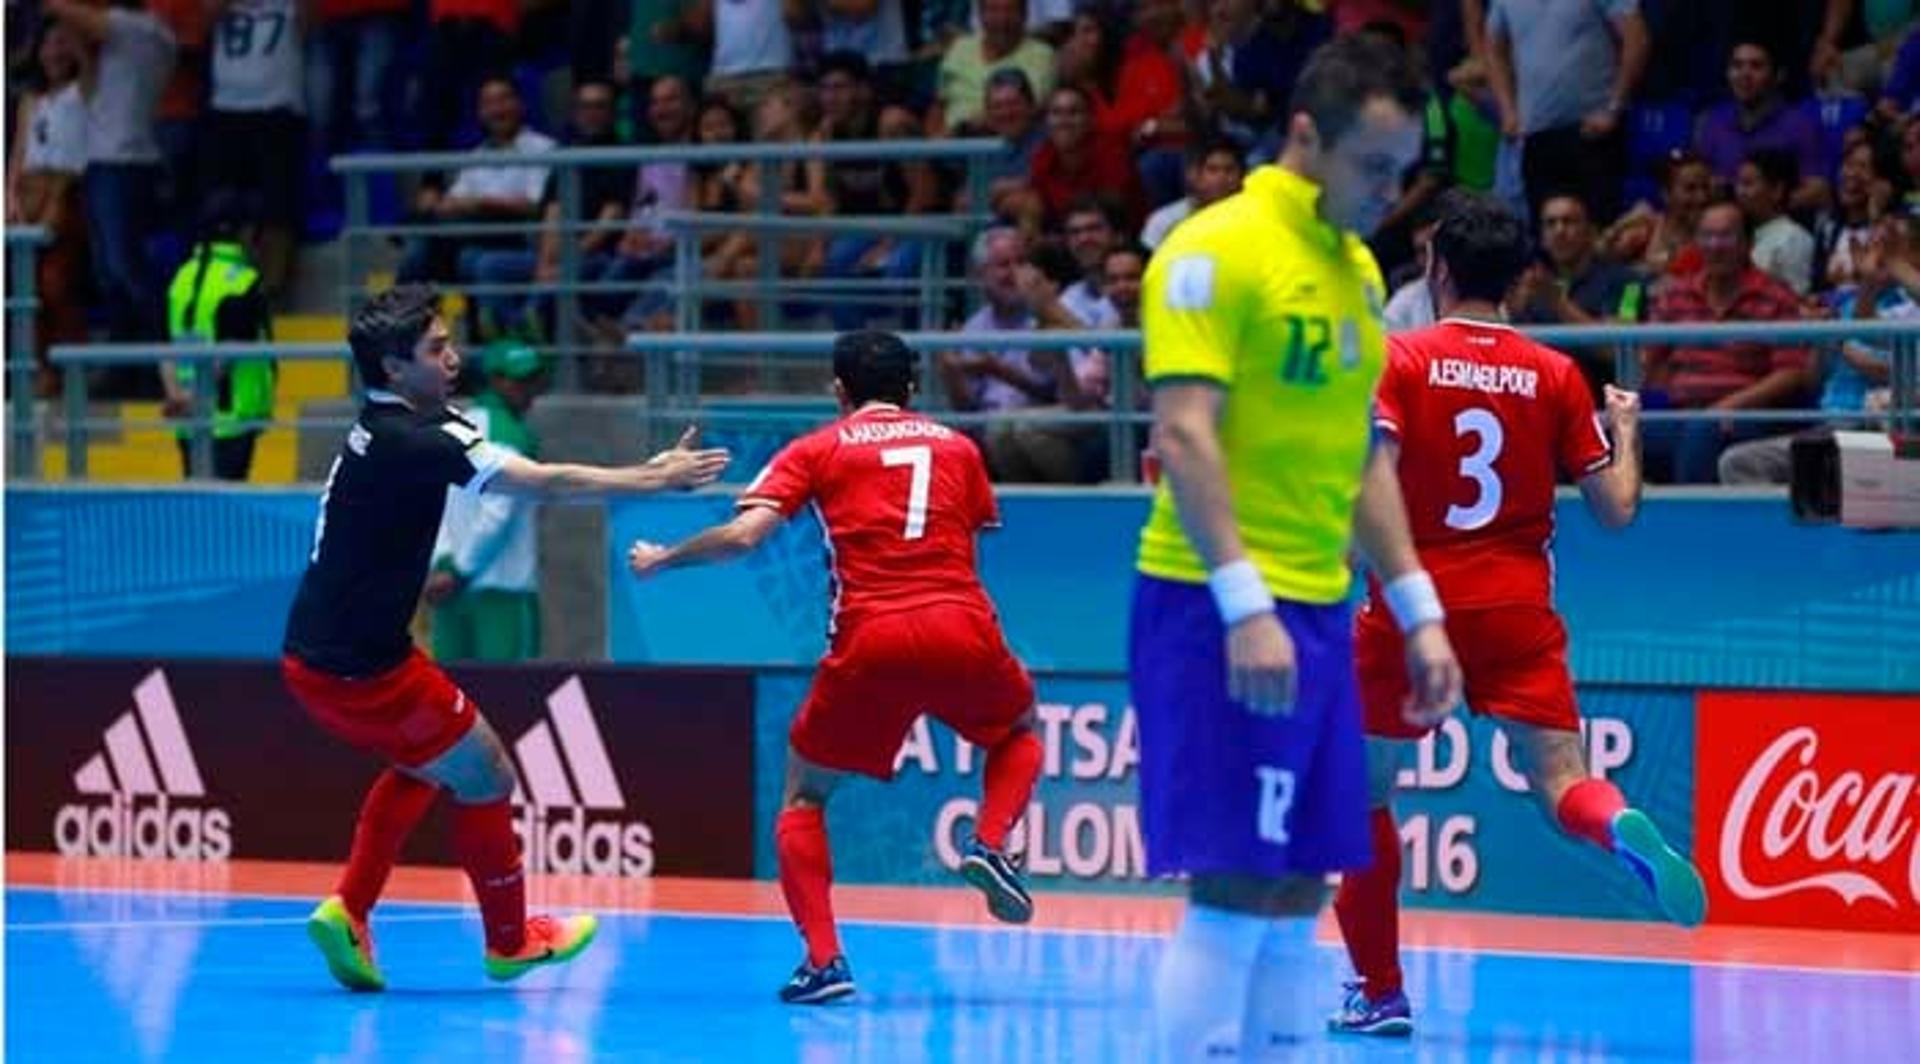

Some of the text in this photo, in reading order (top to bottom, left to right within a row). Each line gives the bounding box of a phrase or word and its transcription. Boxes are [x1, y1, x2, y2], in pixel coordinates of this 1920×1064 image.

[1282, 315, 1330, 385] 12
[880, 445, 932, 540] 7
[1445, 407, 1504, 530] 3
[54, 791, 231, 859] adidas
[511, 802, 656, 877] didas
[1254, 765, 1295, 844] 12
